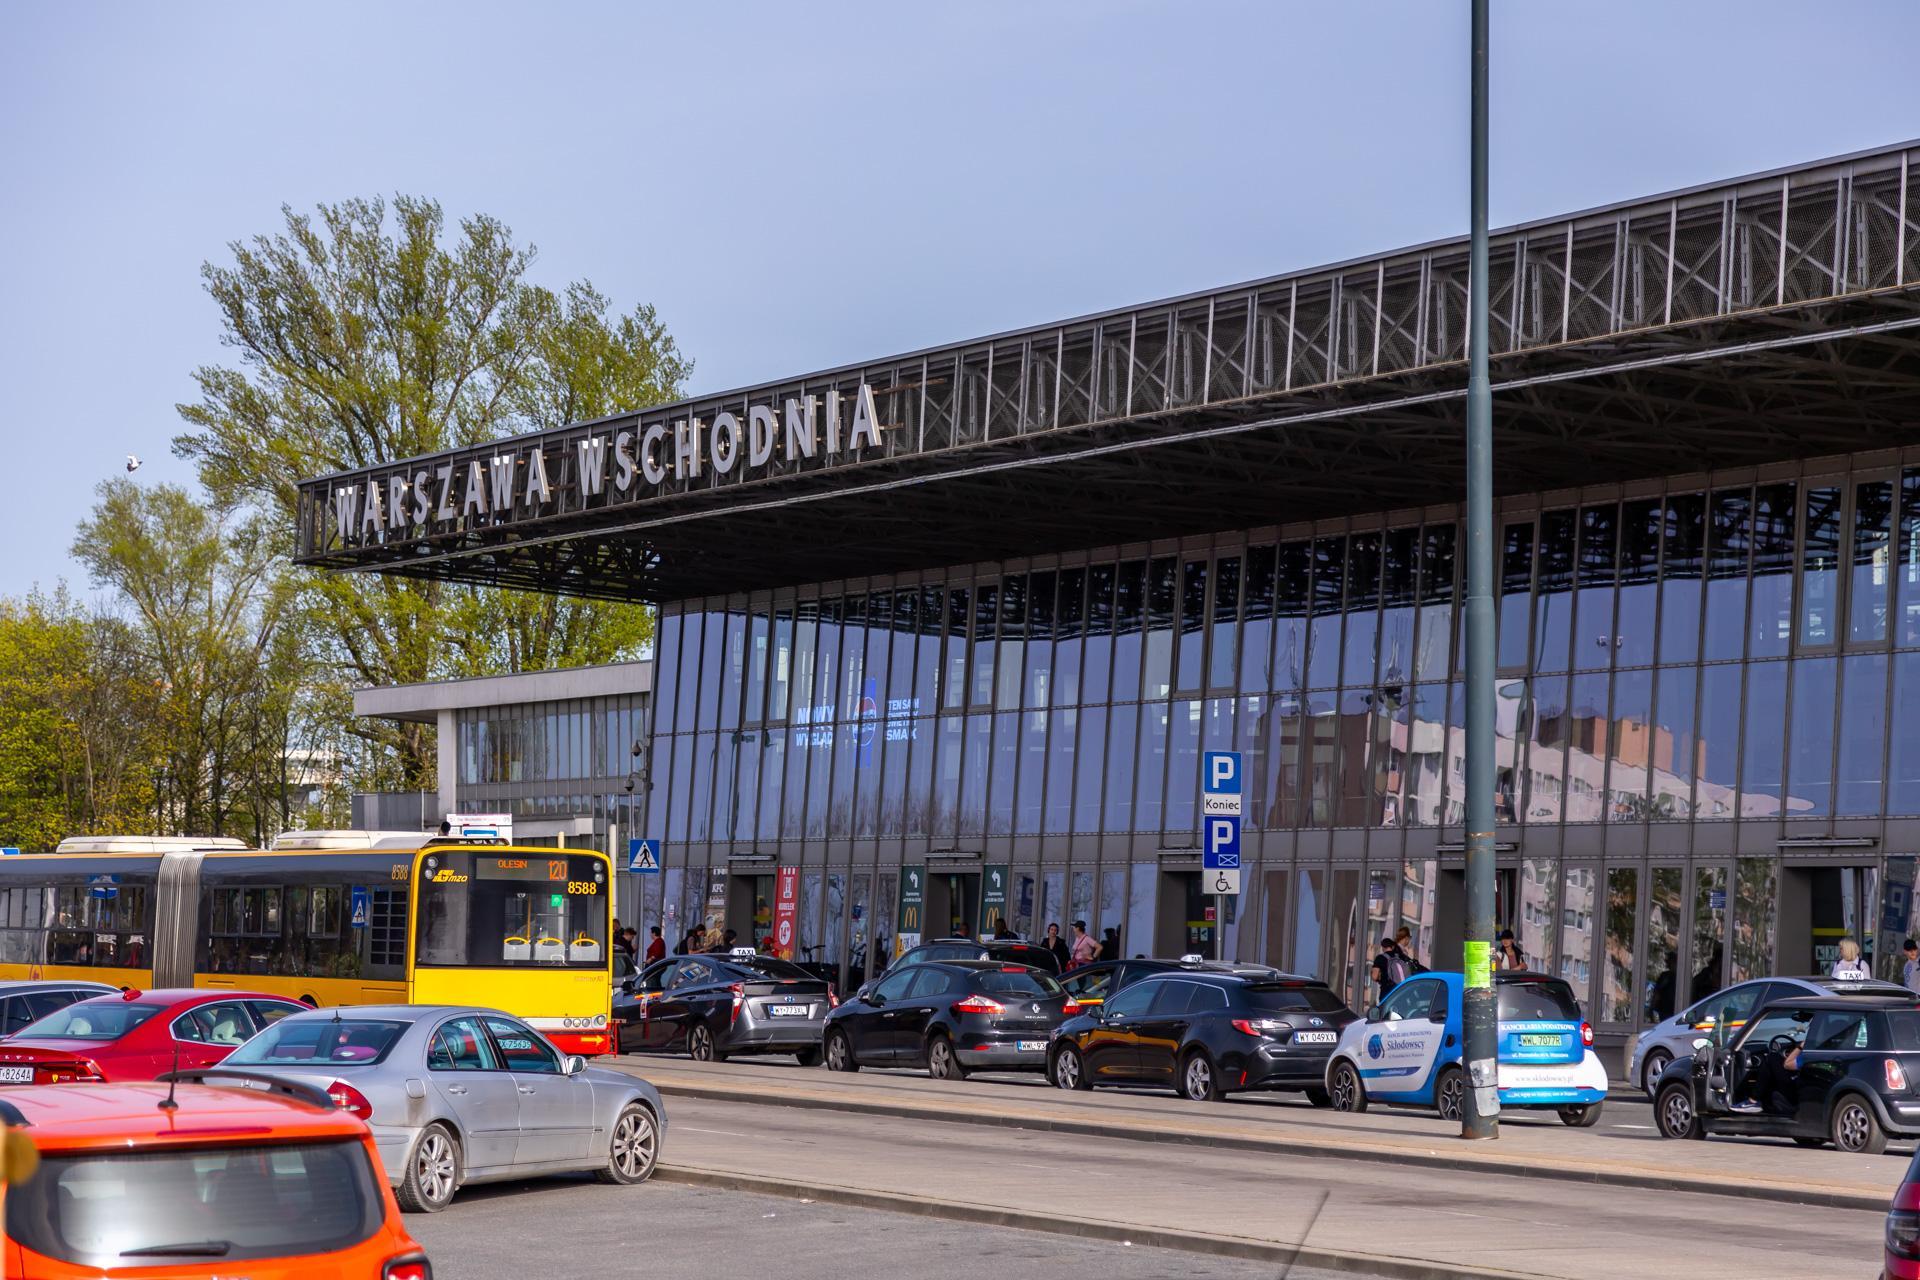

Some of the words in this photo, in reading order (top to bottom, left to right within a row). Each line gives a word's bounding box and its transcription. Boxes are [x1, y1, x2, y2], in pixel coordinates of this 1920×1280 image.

[335, 448, 551, 537] WARSZAWA
[577, 384, 882, 496] WSCHODNIA
[1212, 756, 1234, 788] P
[1205, 798, 1239, 809] Koniec
[1212, 820, 1233, 853] P
[391, 864, 409, 880] 8588
[547, 861, 568, 880] 120
[567, 881, 597, 895] 8588
[5, 1068, 31, 1081] 8264A
